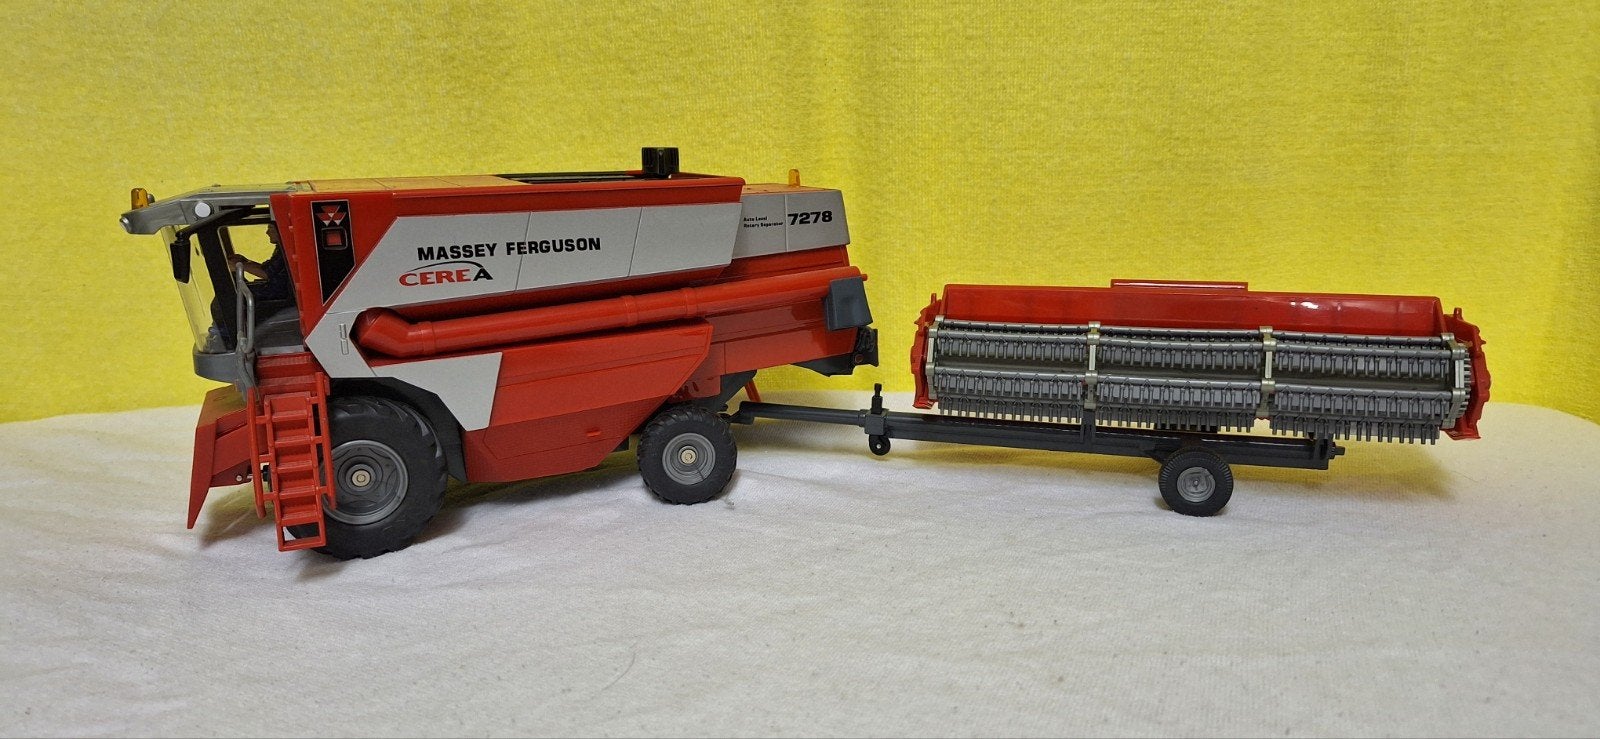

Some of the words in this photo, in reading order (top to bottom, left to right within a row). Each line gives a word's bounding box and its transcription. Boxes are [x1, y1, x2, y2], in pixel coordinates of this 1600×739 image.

[787, 210, 833, 226] 7278
[417, 242, 498, 261] MASSEY
[506, 237, 601, 256] FERGUSON
[398, 267, 493, 287] CEREA
